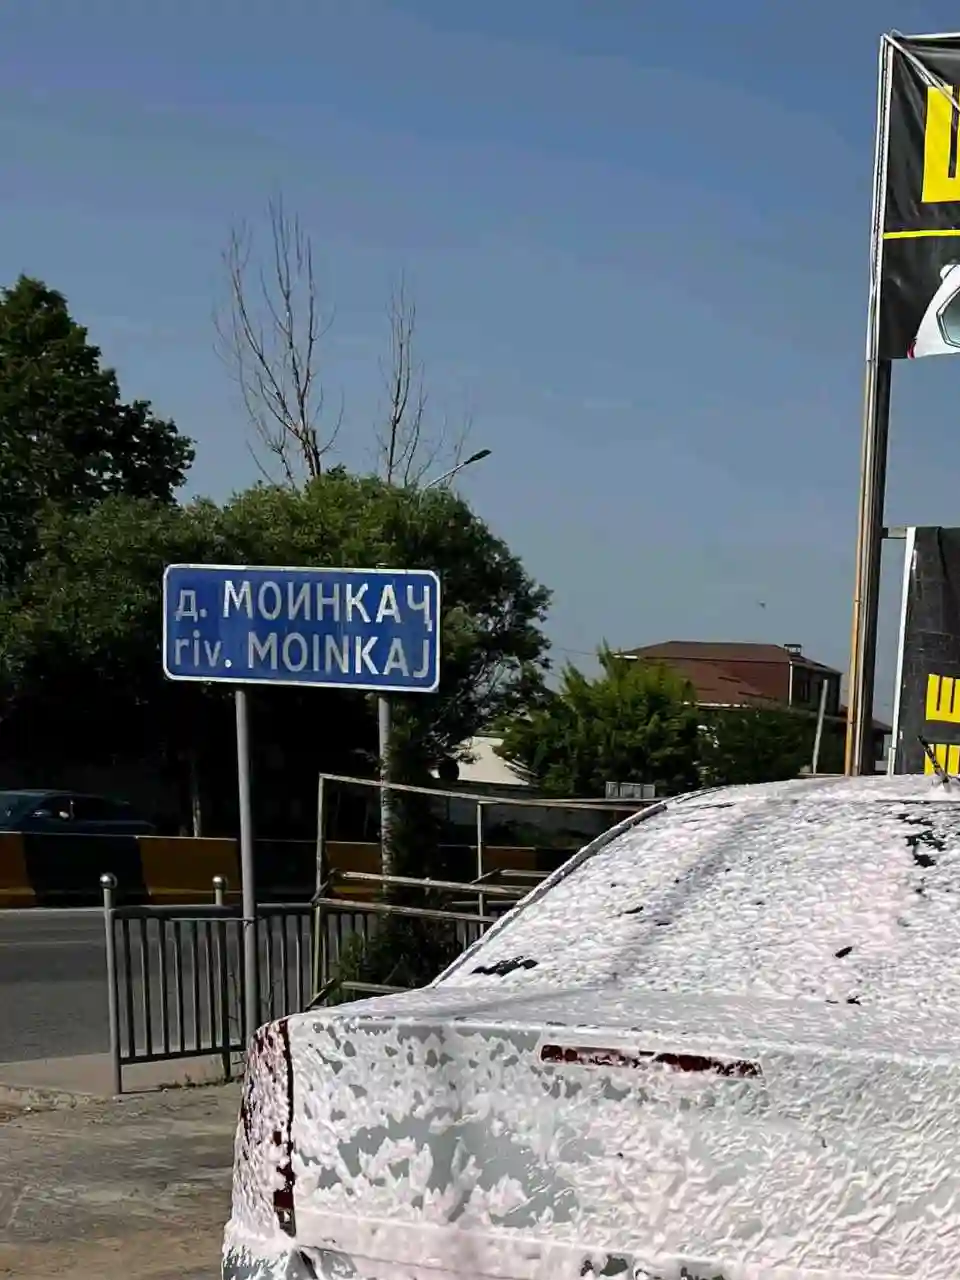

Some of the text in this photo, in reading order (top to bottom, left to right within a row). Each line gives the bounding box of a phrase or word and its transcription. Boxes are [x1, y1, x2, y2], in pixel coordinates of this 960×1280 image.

[174, 589, 208, 622] д.
[174, 630, 430, 679] riv. MOINKAJ
